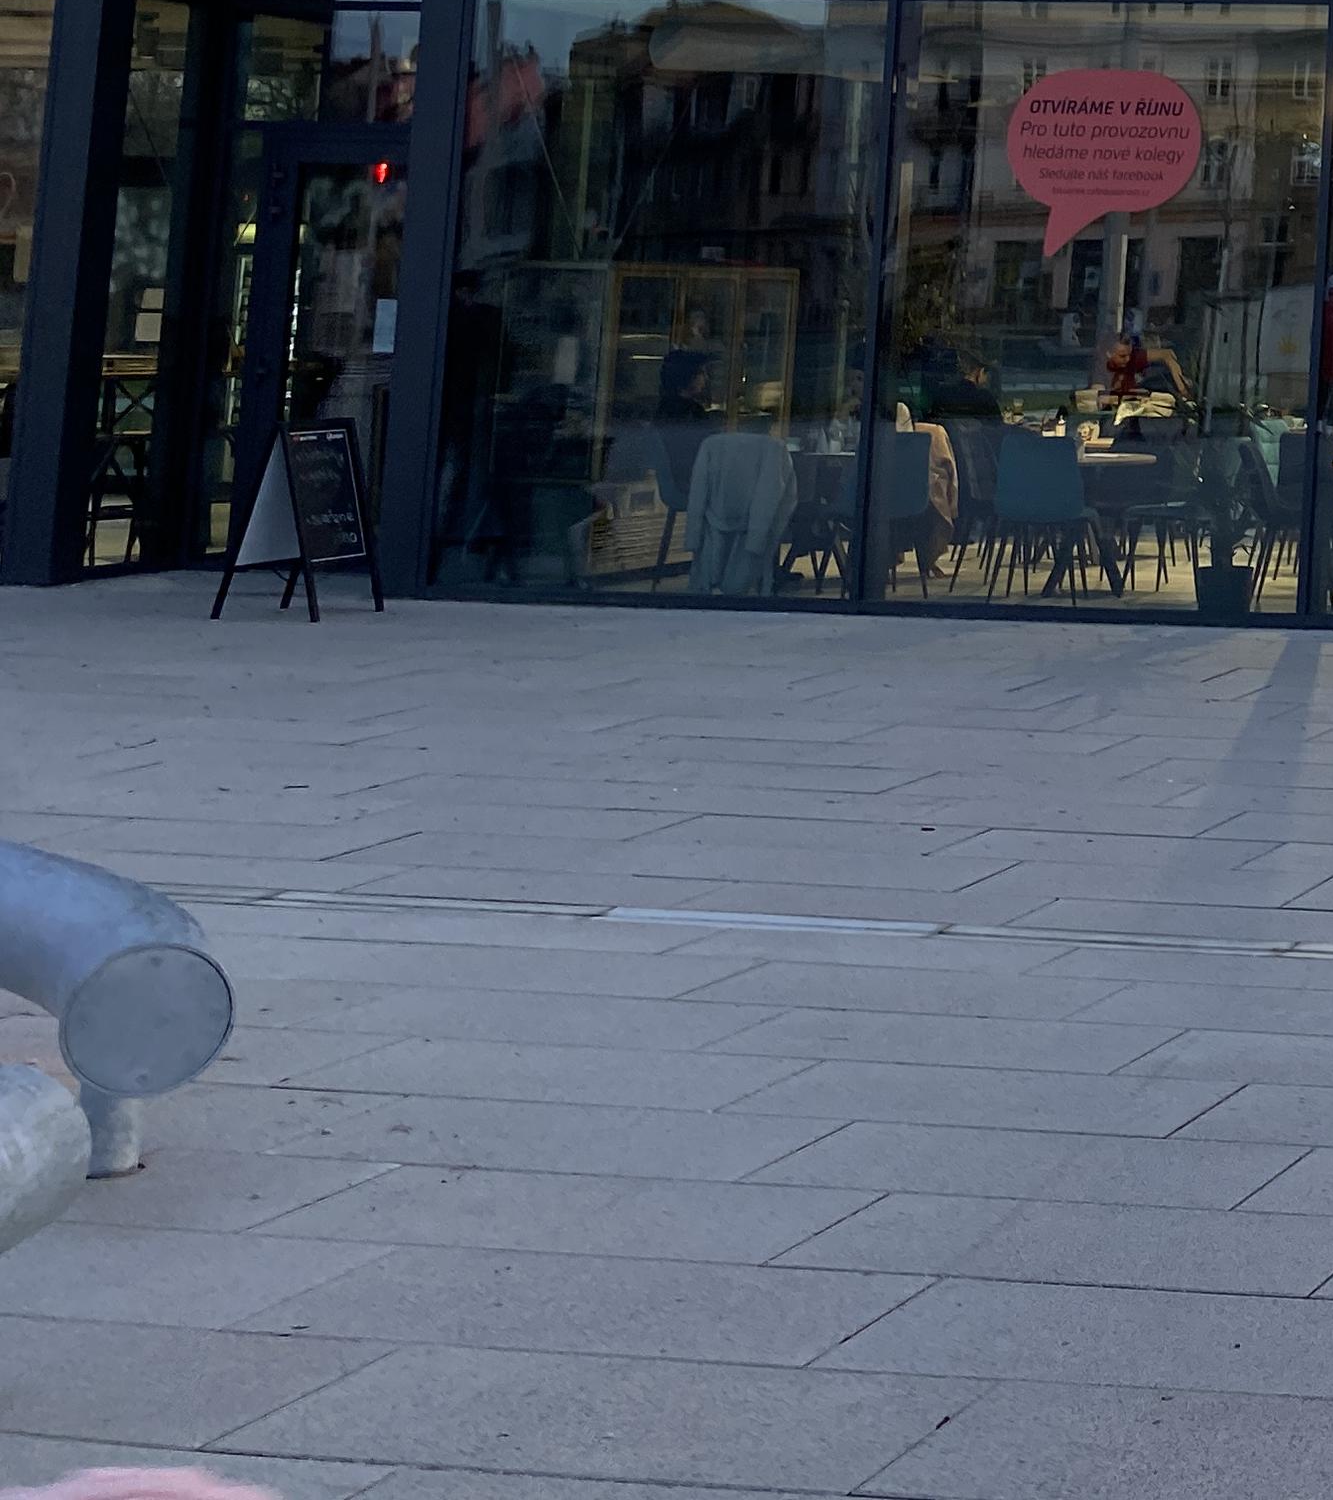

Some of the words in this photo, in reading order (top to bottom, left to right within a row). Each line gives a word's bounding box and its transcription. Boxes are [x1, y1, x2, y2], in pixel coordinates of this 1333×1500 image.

[1029, 95, 1115, 115] OTVÍRÁME
[1119, 100, 1131, 115] V
[1134, 97, 1185, 117] ŘÍJNU
[1020, 121, 1047, 137] Pro
[1053, 122, 1086, 137] tuto
[1090, 125, 1190, 141] provozovnu
[1022, 143, 1089, 160] hledáme
[1092, 145, 1130, 161] nové
[1134, 145, 1185, 165] kolegy
[1039, 168, 1086, 180] Sledujte
[1112, 169, 1164, 181] facebook
